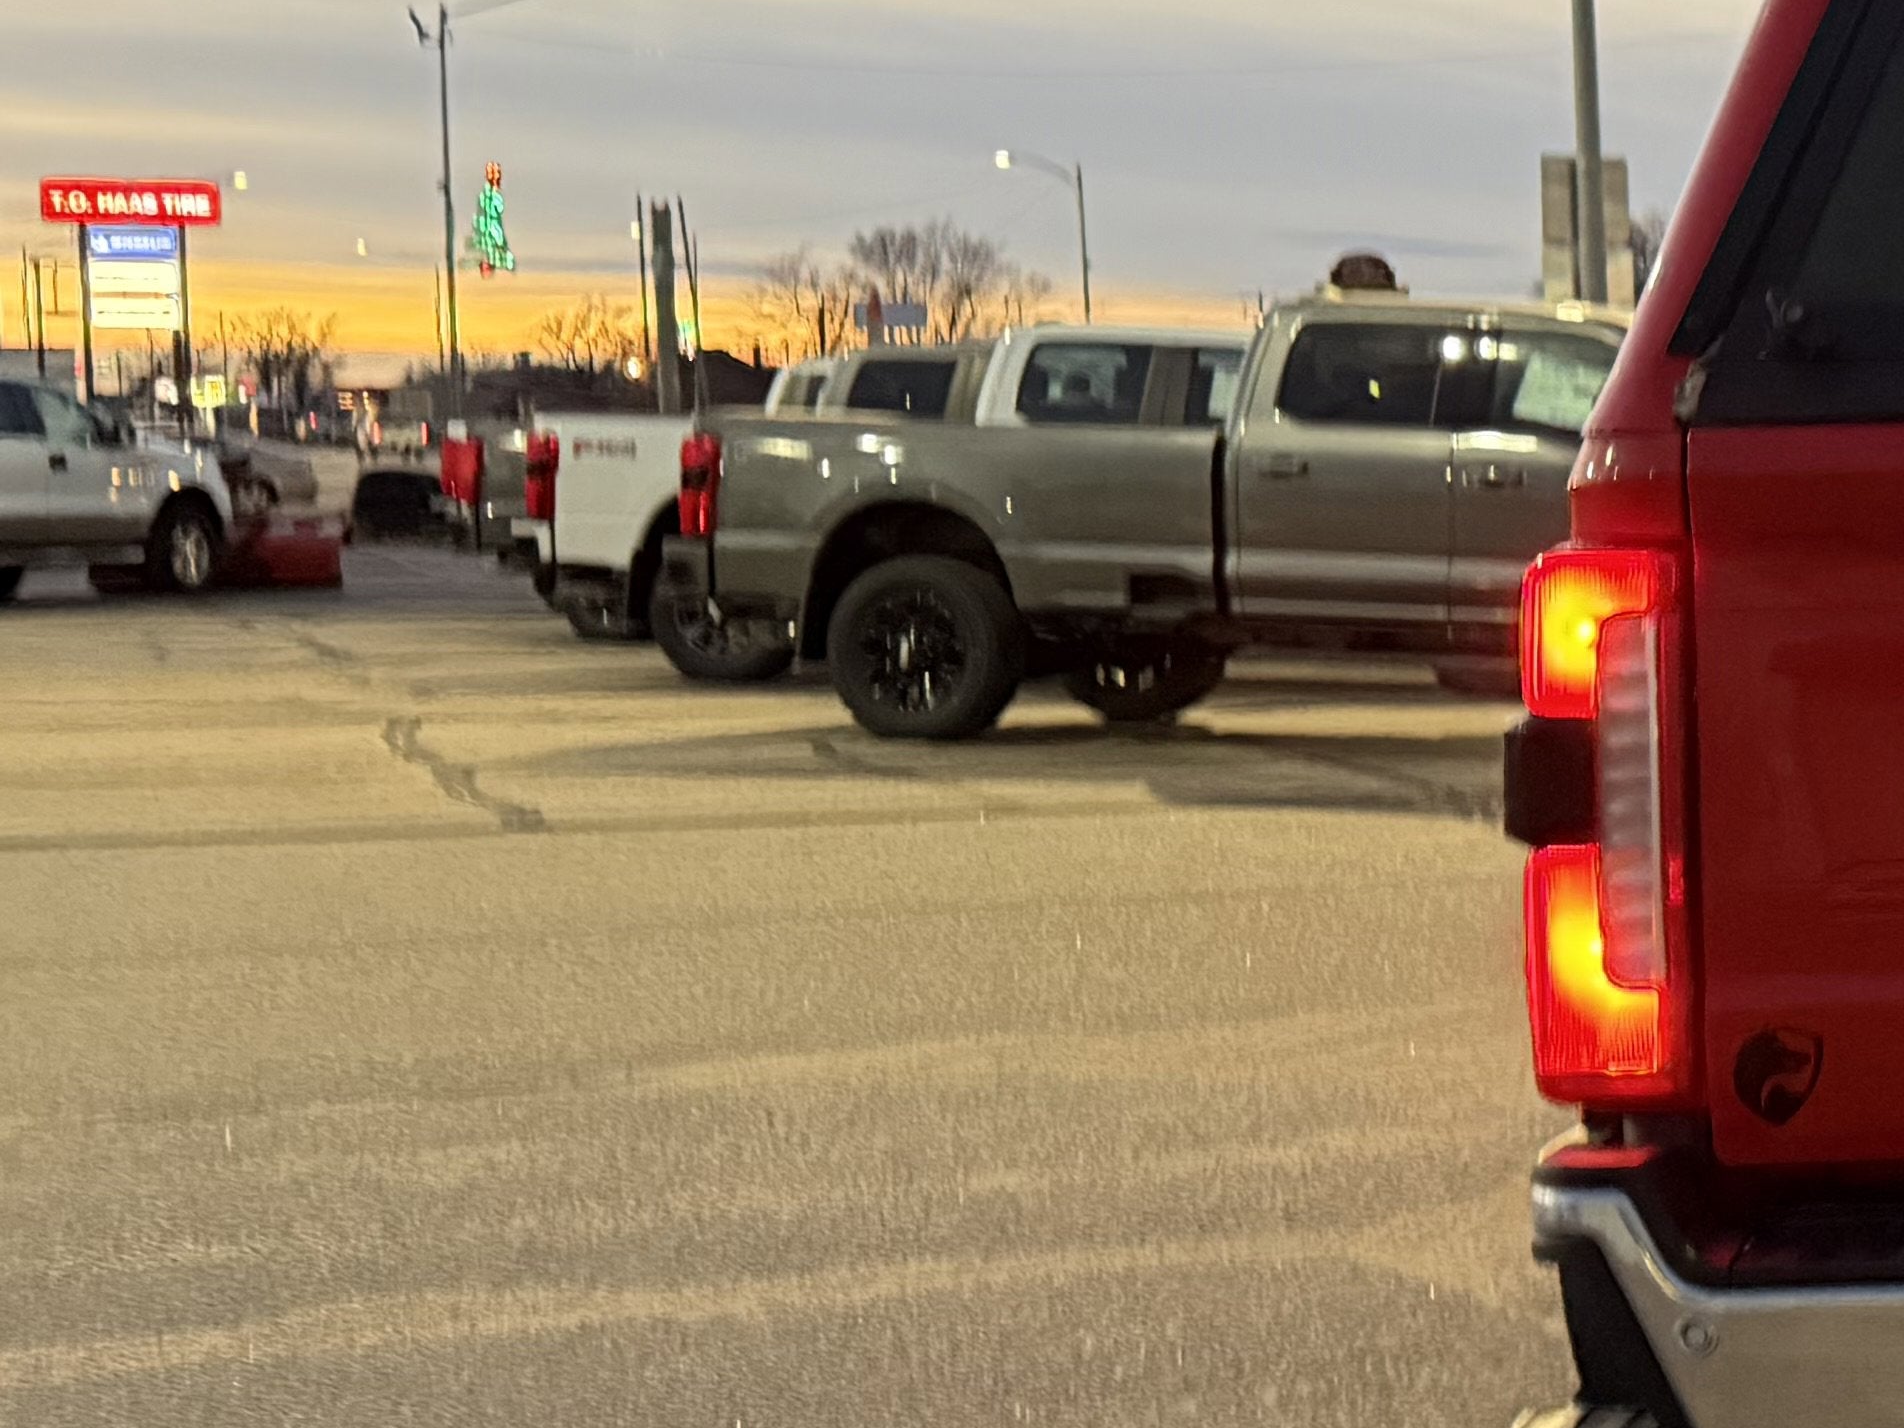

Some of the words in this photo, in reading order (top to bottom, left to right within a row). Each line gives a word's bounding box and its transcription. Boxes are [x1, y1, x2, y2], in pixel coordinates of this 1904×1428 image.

[49, 189, 92, 214] T.O.
[97, 191, 158, 215] HAAS
[162, 193, 212, 217] TIRE
